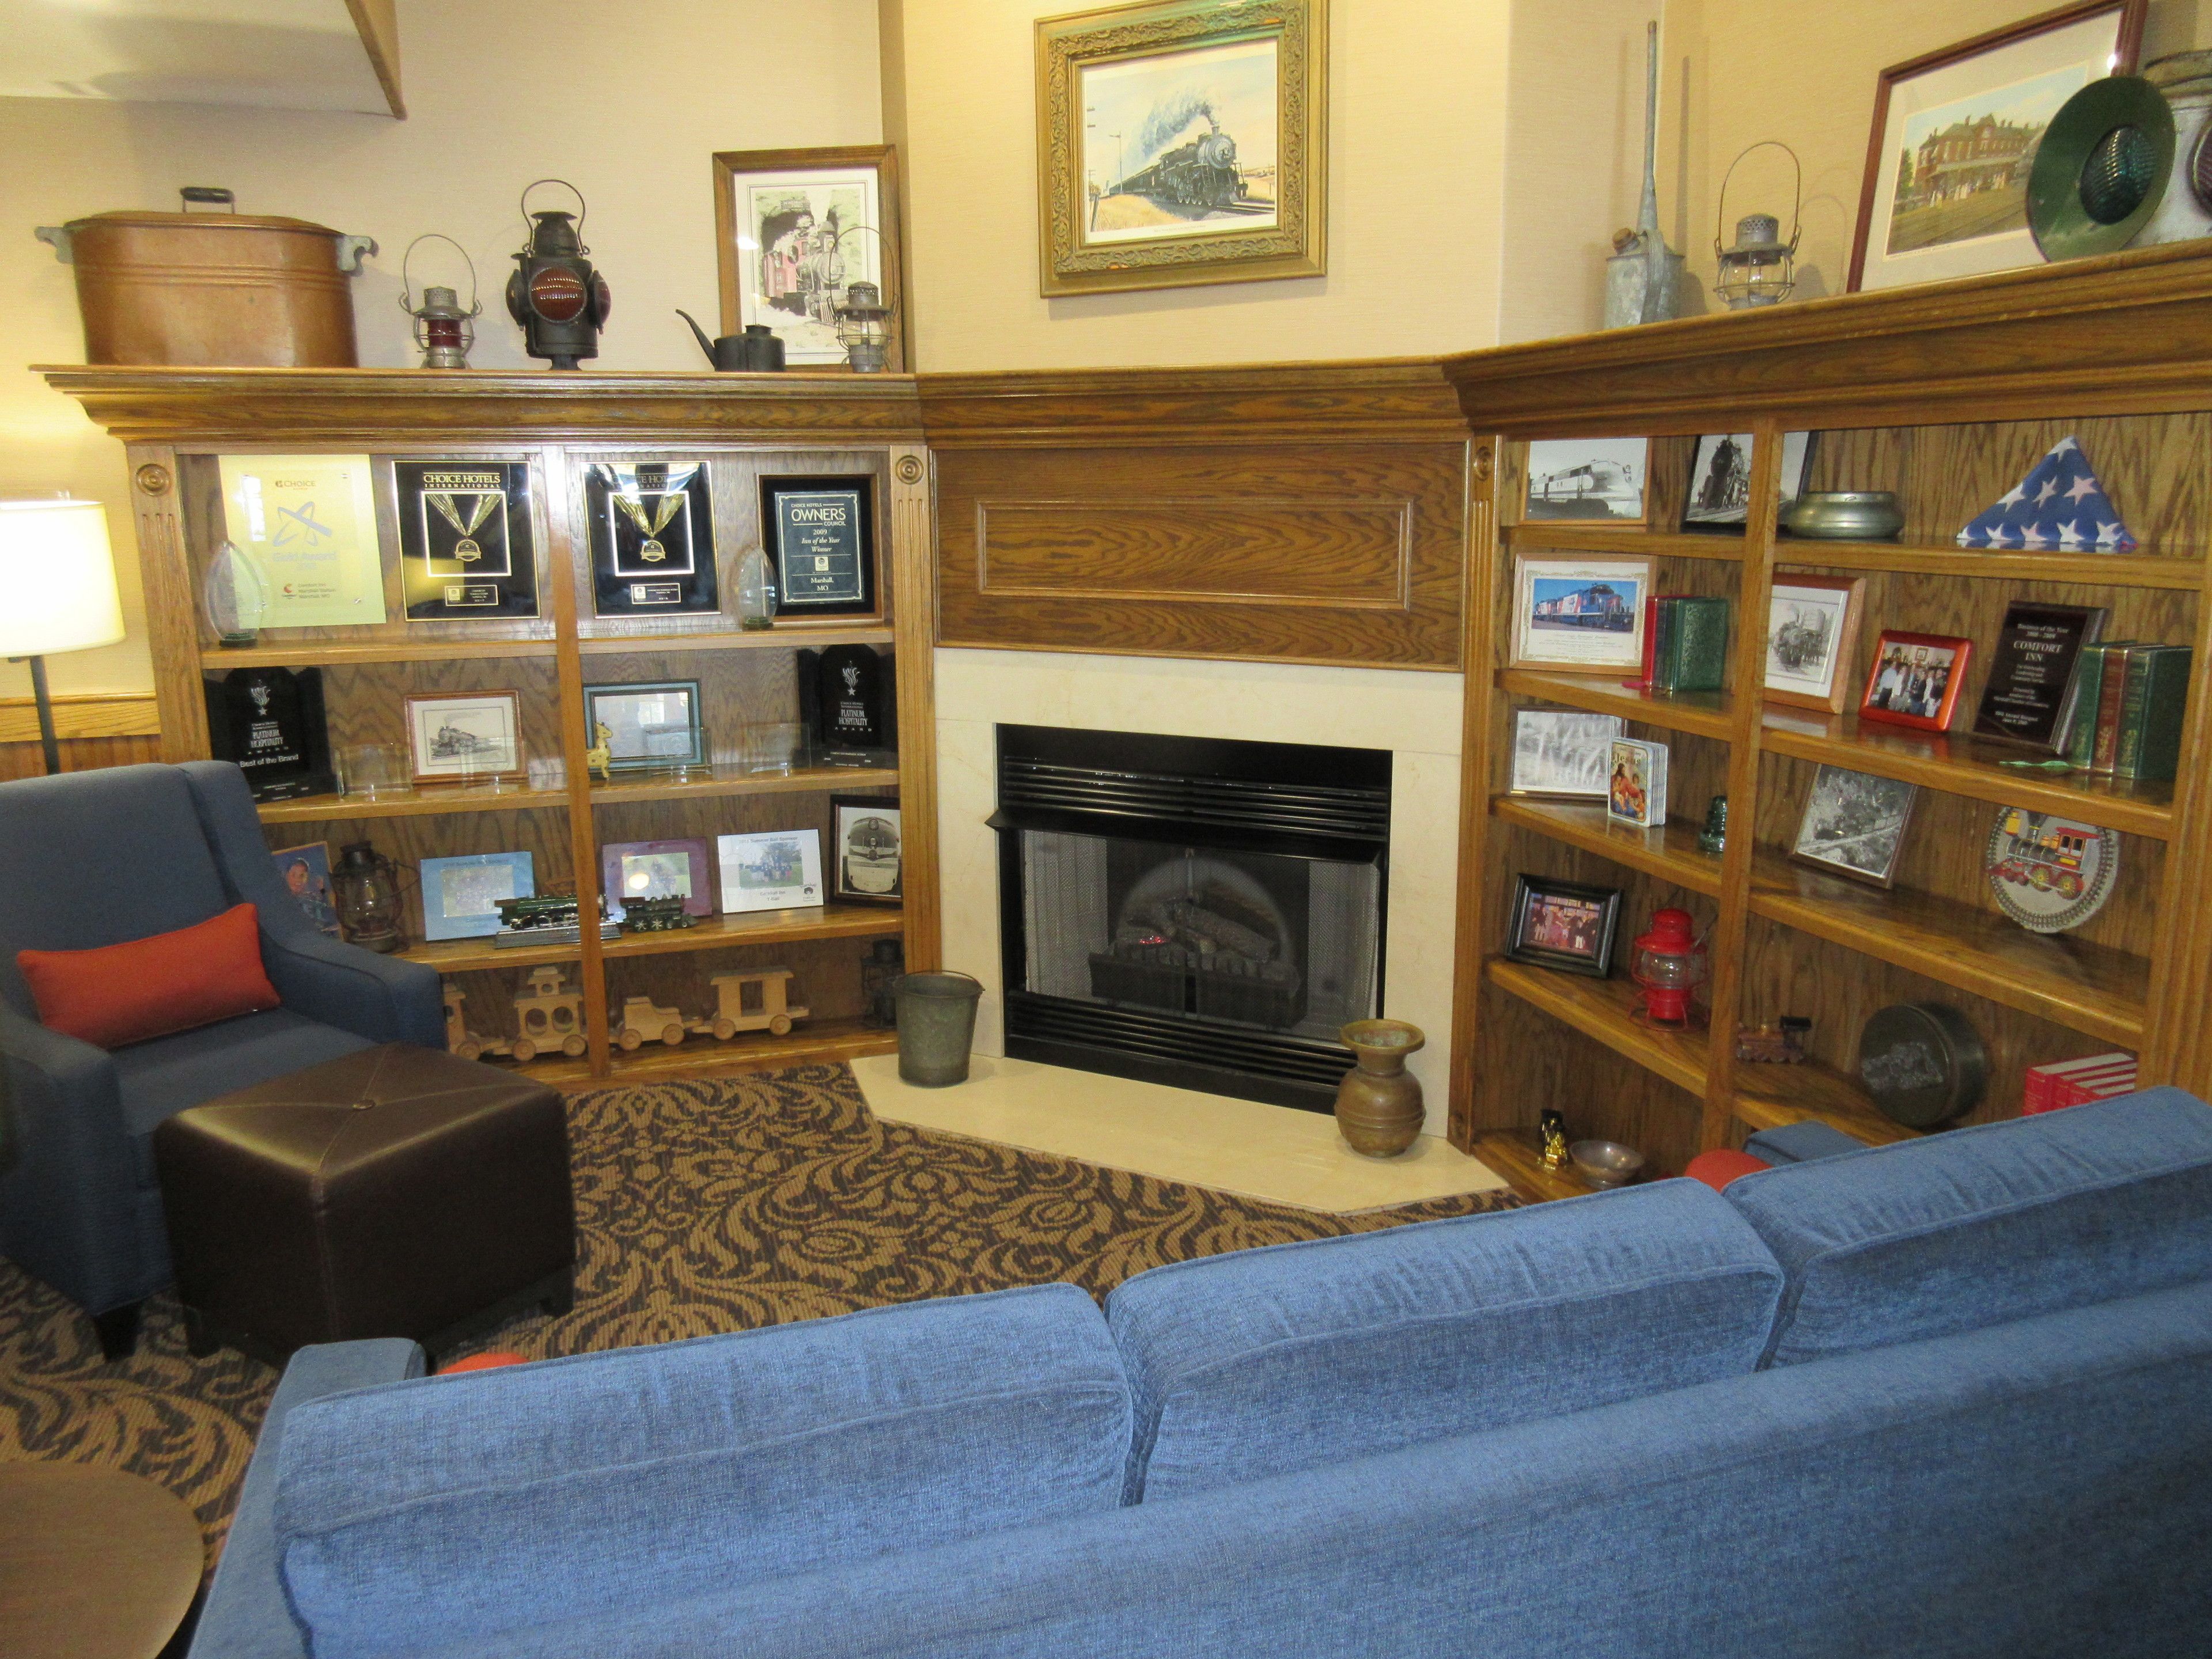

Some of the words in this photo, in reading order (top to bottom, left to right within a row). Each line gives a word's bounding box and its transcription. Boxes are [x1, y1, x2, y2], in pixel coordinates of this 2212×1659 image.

[423, 475, 461, 483] CHOICE
[463, 475, 501, 483] HOTELS
[791, 508, 846, 522] OWNERS
[2013, 640, 2063, 653] COMFORT
[2025, 652, 2044, 662] INN
[841, 709, 865, 718] PLATINUM
[839, 717, 868, 725] HOSPITALITY
[278, 753, 298, 762] Brand
